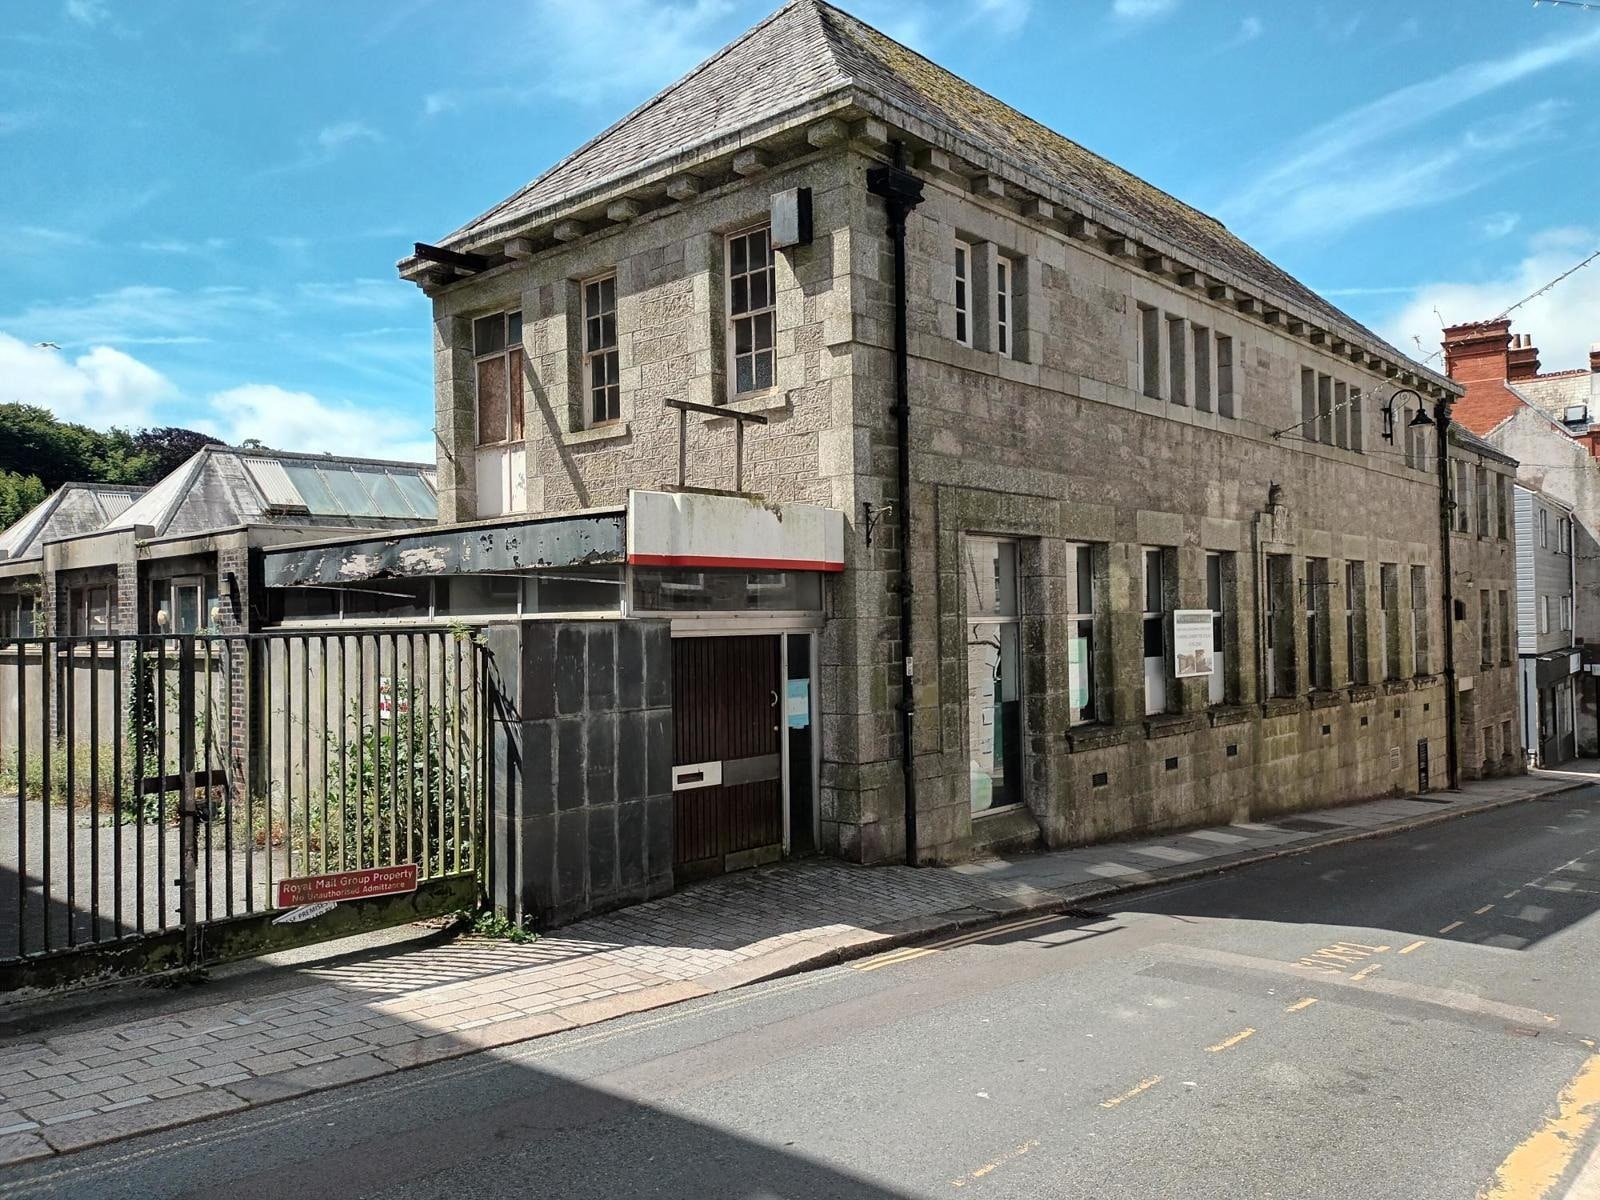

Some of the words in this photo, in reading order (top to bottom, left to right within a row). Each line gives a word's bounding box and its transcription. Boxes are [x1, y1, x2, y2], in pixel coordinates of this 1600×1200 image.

[283, 882, 312, 893] Royal
[315, 878, 337, 889] Mail
[340, 875, 371, 886] Group
[373, 869, 414, 882] Property
[292, 894, 305, 902] No
[308, 887, 360, 900] Unauthorised
[363, 881, 405, 893] Admittance
